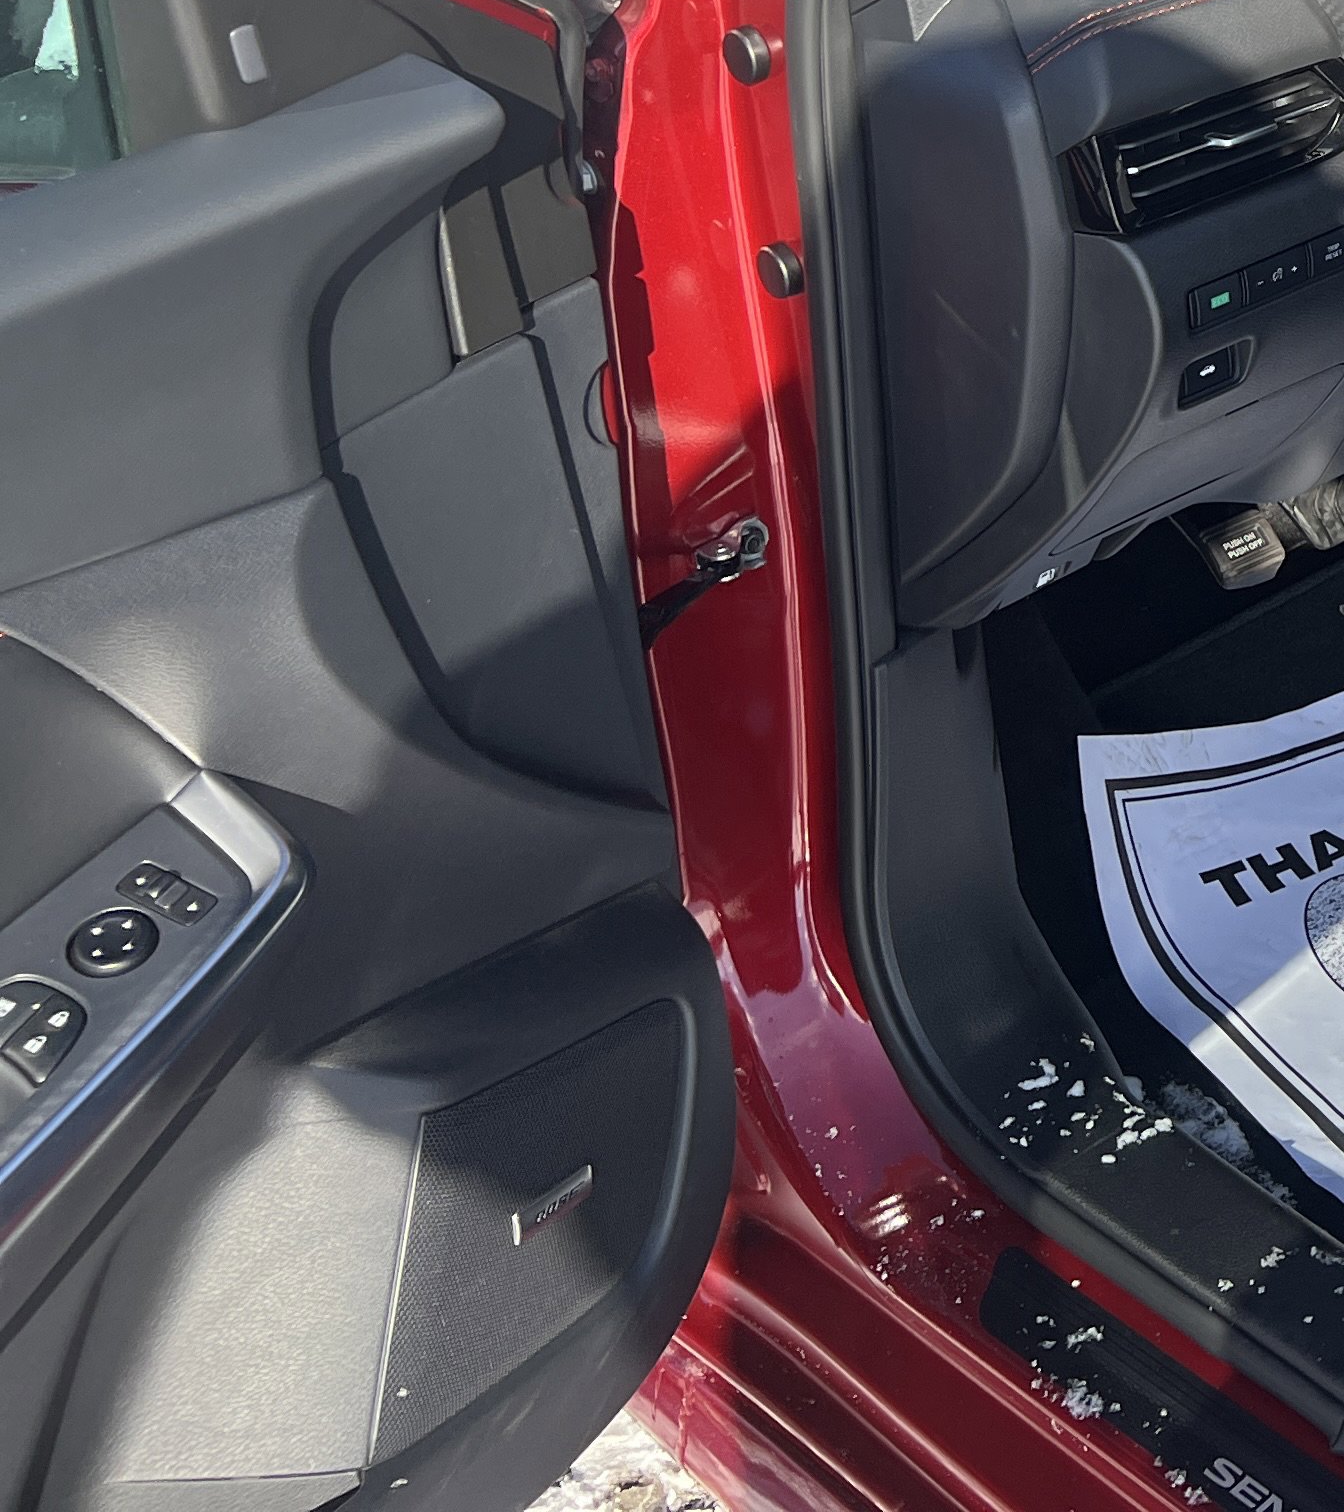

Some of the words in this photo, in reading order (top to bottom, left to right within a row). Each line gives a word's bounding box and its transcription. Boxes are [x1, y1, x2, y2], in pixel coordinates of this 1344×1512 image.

[1222, 536, 1244, 551] PUSH
[1243, 531, 1257, 542] ON
[1227, 544, 1250, 559] PUSH
[1248, 537, 1265, 550] OFF
